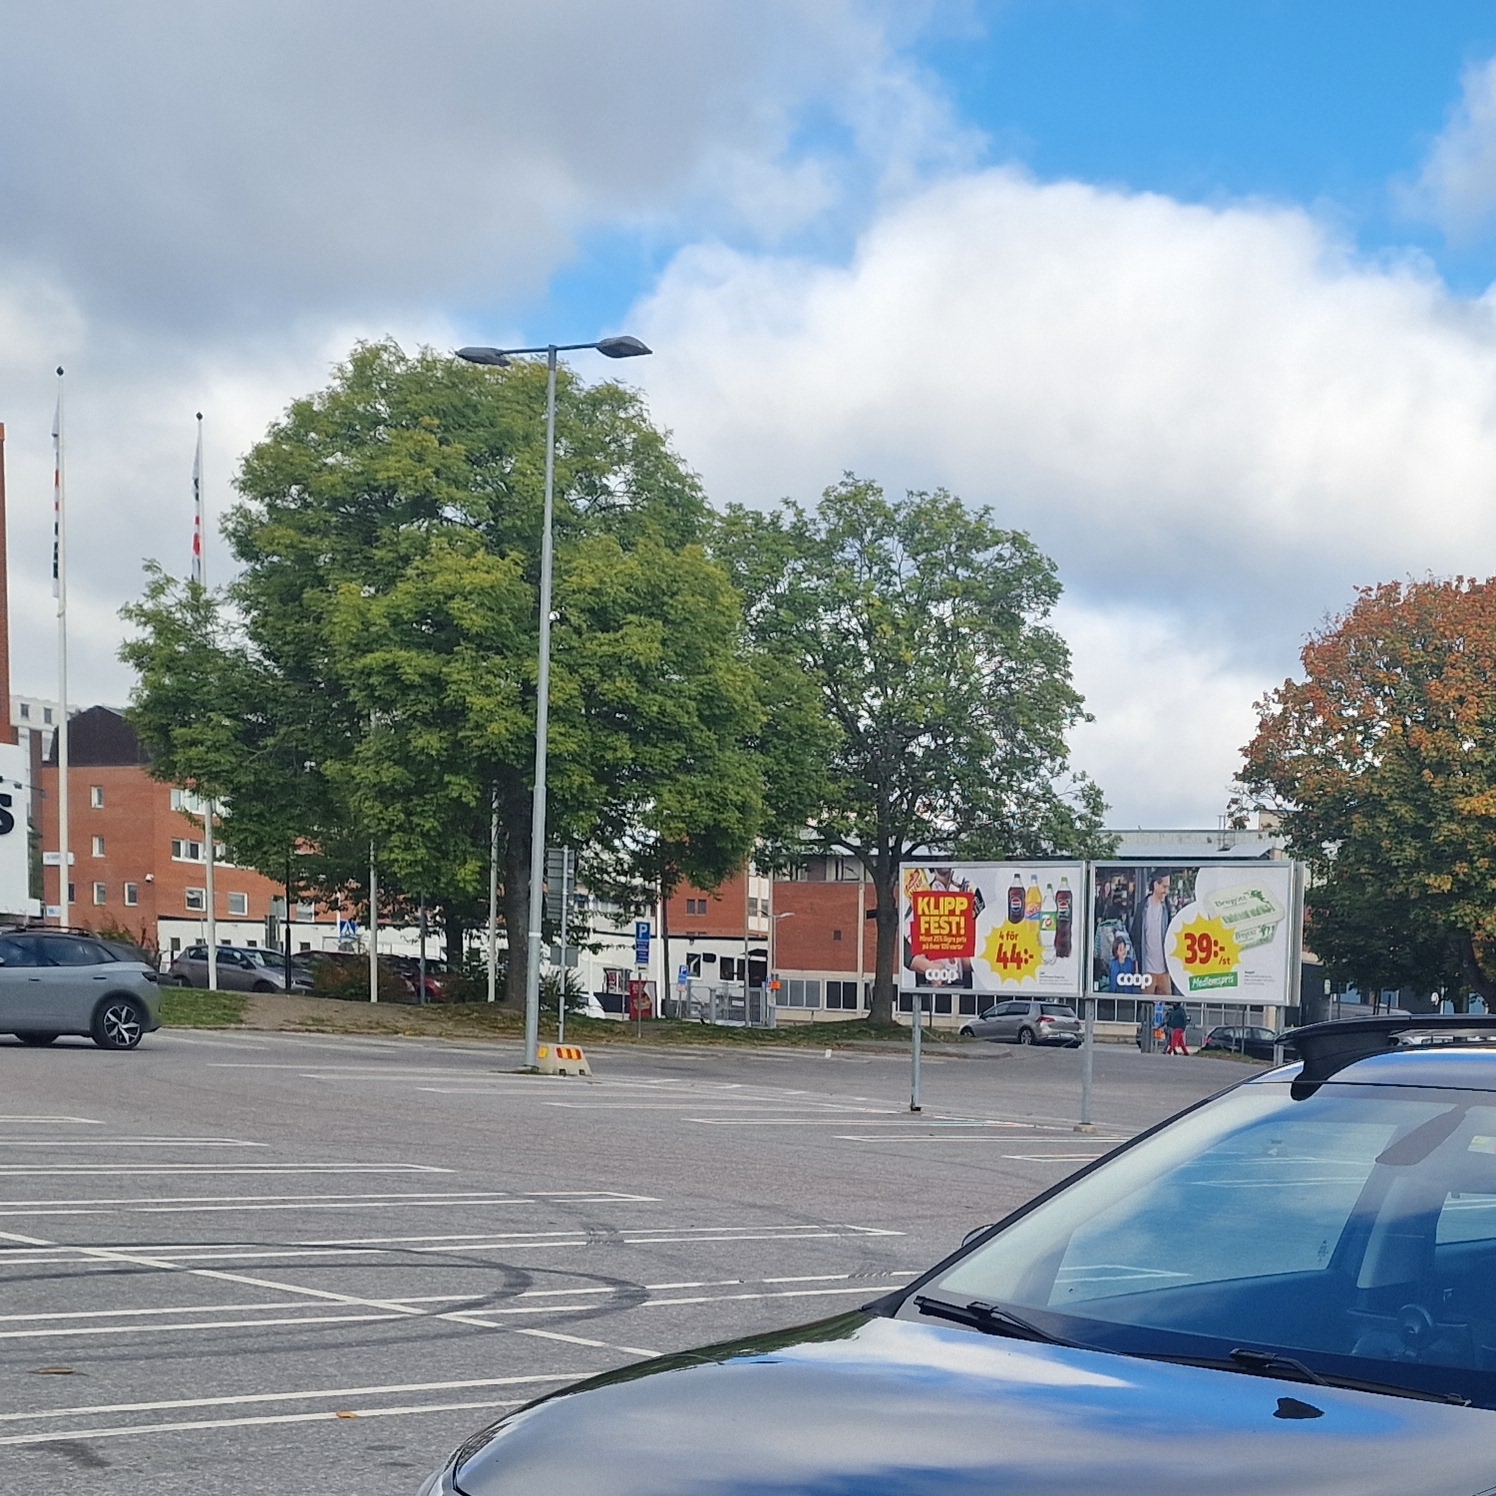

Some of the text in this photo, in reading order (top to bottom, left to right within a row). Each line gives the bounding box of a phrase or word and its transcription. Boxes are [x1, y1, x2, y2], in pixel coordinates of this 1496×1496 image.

[917, 896, 969, 915] KLIPP
[639, 923, 648, 938] P
[920, 916, 966, 935] FEST!
[999, 931, 1020, 941] 4 för
[996, 943, 1034, 970] 44:-
[1184, 933, 1226, 965] 39:-
[925, 969, 958, 984] coop
[1117, 972, 1153, 990] coop
